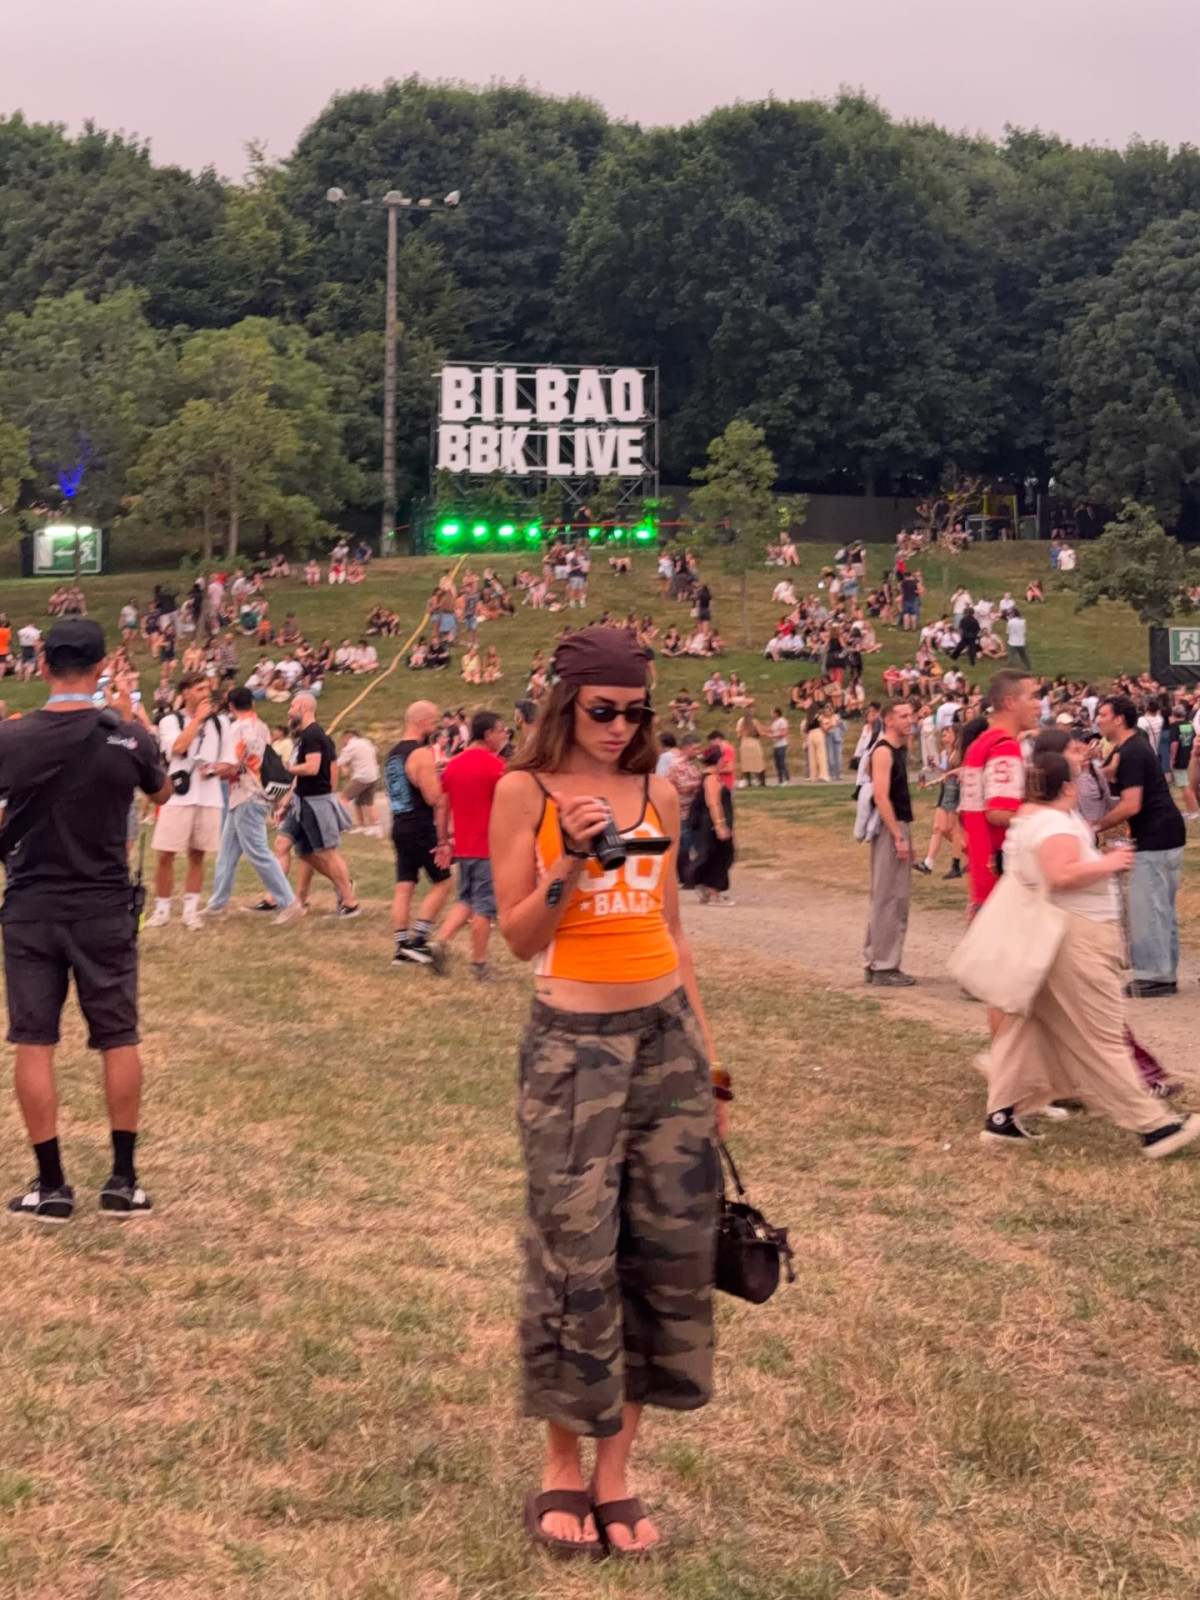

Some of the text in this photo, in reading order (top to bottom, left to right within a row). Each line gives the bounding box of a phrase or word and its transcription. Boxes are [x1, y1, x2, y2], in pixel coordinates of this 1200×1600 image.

[441, 366, 645, 423] BILBAO
[438, 424, 644, 476] BBK LIVE
